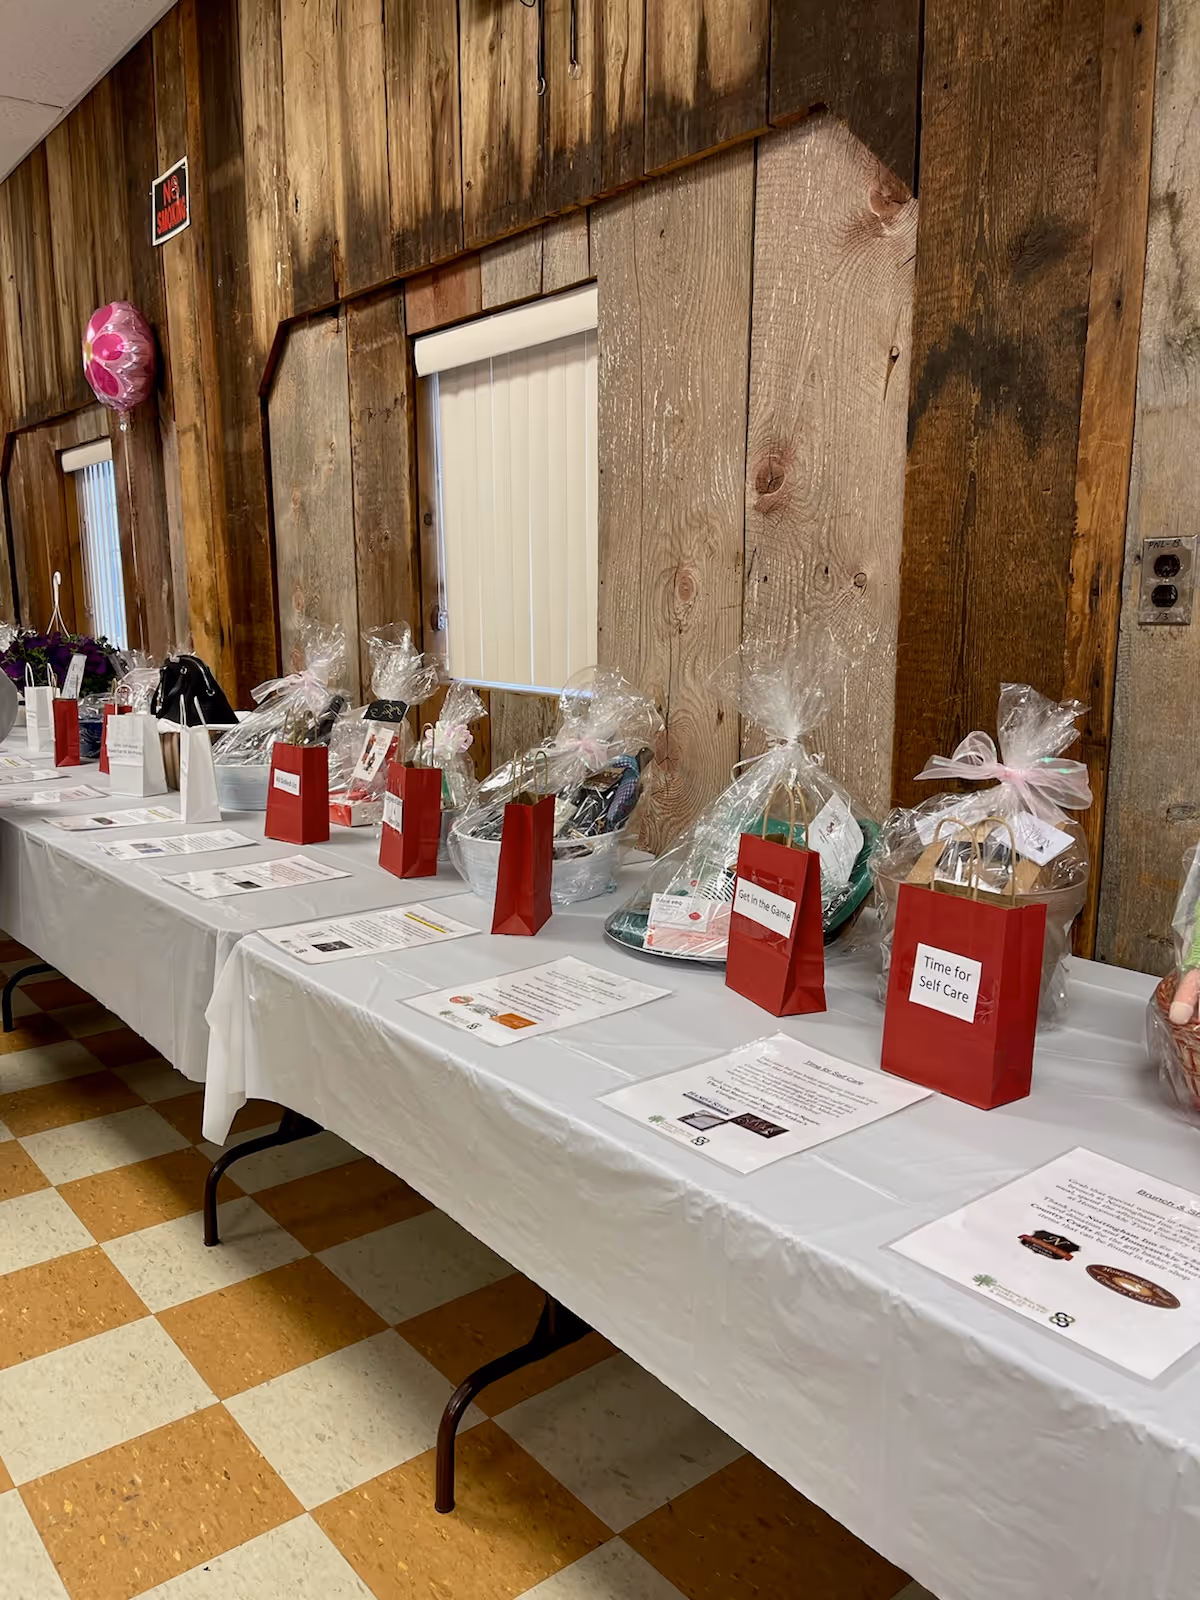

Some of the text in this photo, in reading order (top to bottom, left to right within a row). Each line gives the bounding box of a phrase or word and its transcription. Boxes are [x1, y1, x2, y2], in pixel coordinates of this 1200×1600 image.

[163, 175, 178, 206] NO
[738, 890, 790, 922] Get in the Game
[924, 955, 971, 982] Time for
[919, 976, 968, 1003] Self Care
[1068, 1184, 1094, 1197] brunch
[1107, 1199, 1156, 1222] Nottingham
[1090, 1188, 1106, 1196] that
[1107, 1195, 1135, 1207] special
[1136, 1188, 1174, 1208] Brunch
[1031, 1203, 1062, 1219] Country
[1066, 1219, 1092, 1232] Crafts
[1123, 1244, 1140, 1252] gift
[1141, 1250, 1170, 1264] basket
[1044, 1196, 1067, 1209] Thank
[1086, 1215, 1140, 1240] Nottingham
[1142, 1238, 1158, 1247] Inn
[1047, 1205, 1066, 1213] card
[1066, 1213, 1101, 1230] donation
[1102, 1229, 1119, 1237] and
[1120, 1235, 1180, 1262] Honeysuckle
[1078, 1200, 1128, 1222] Honeysuckle
[1131, 1221, 1152, 1232] Trail
[1154, 1231, 1190, 1247] Country
[1116, 1210, 1156, 1228] afternoon
[1038, 1213, 1059, 1224] items
[1061, 1223, 1078, 1232] that
[1080, 1231, 1094, 1239] can
[1107, 1242, 1133, 1256] found
[1145, 1259, 1167, 1270] their
